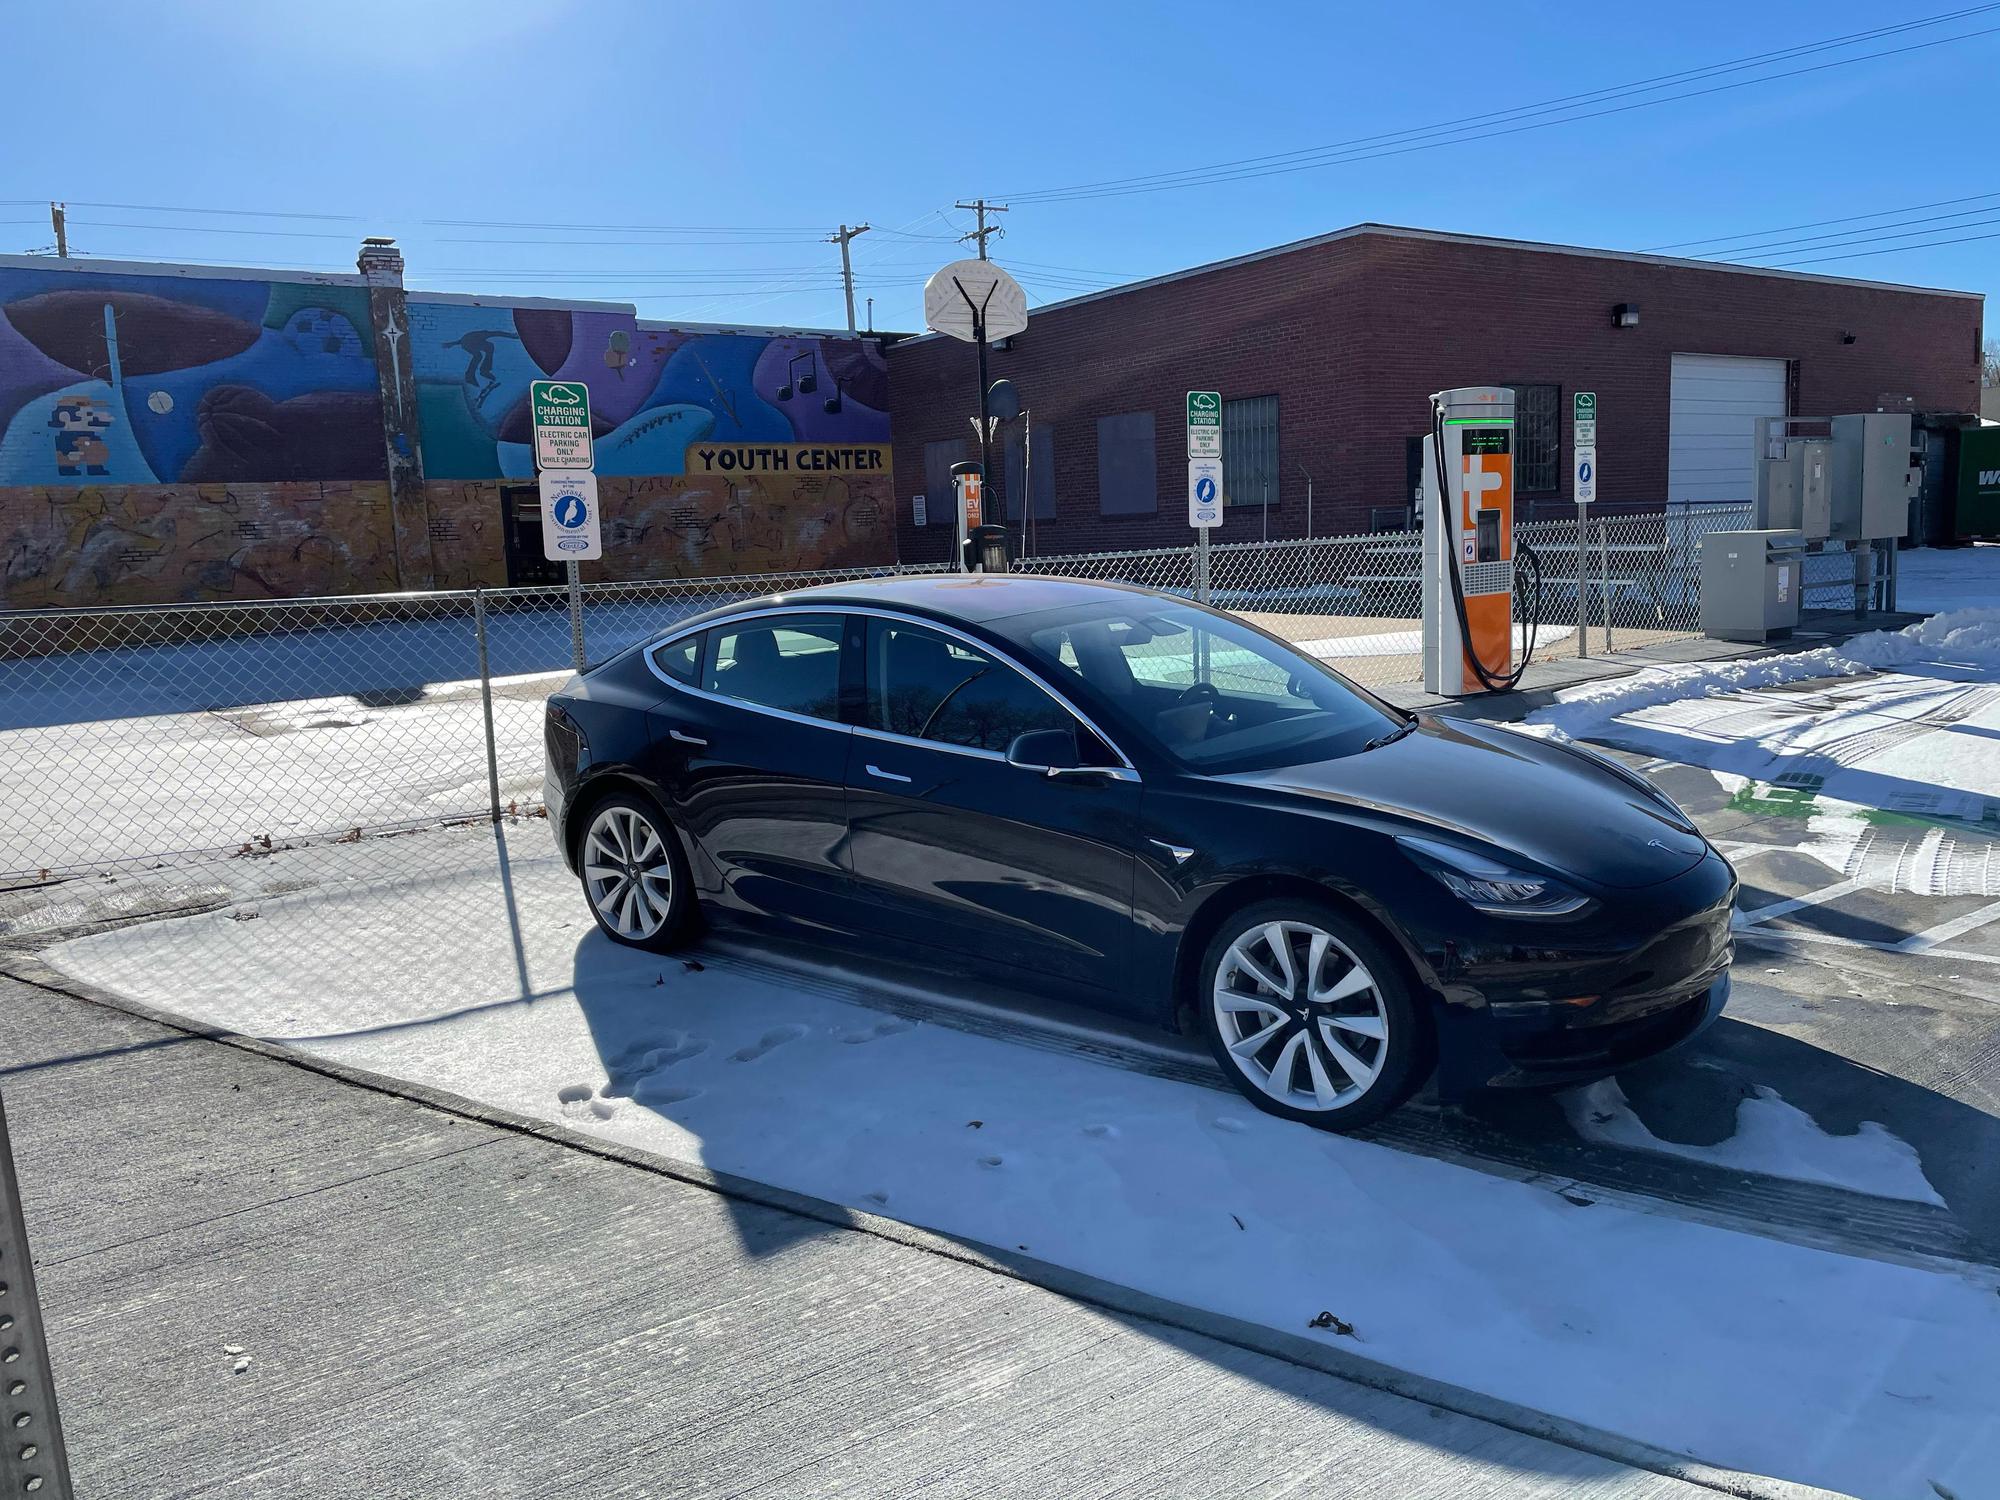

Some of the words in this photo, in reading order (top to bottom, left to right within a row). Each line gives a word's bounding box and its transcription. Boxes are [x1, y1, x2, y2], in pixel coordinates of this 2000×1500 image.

[538, 406, 585, 416] CHARGING
[543, 416, 581, 425] STATION
[540, 431, 572, 439] ELECTRIC
[573, 431, 588, 439] CAR
[549, 440, 580, 448] PARKING
[556, 448, 574, 456] ONLY
[698, 449, 789, 471] YOUTH
[796, 449, 882, 471] CENTER
[550, 489, 587, 503] Nebraska
[967, 498, 979, 509] EV
